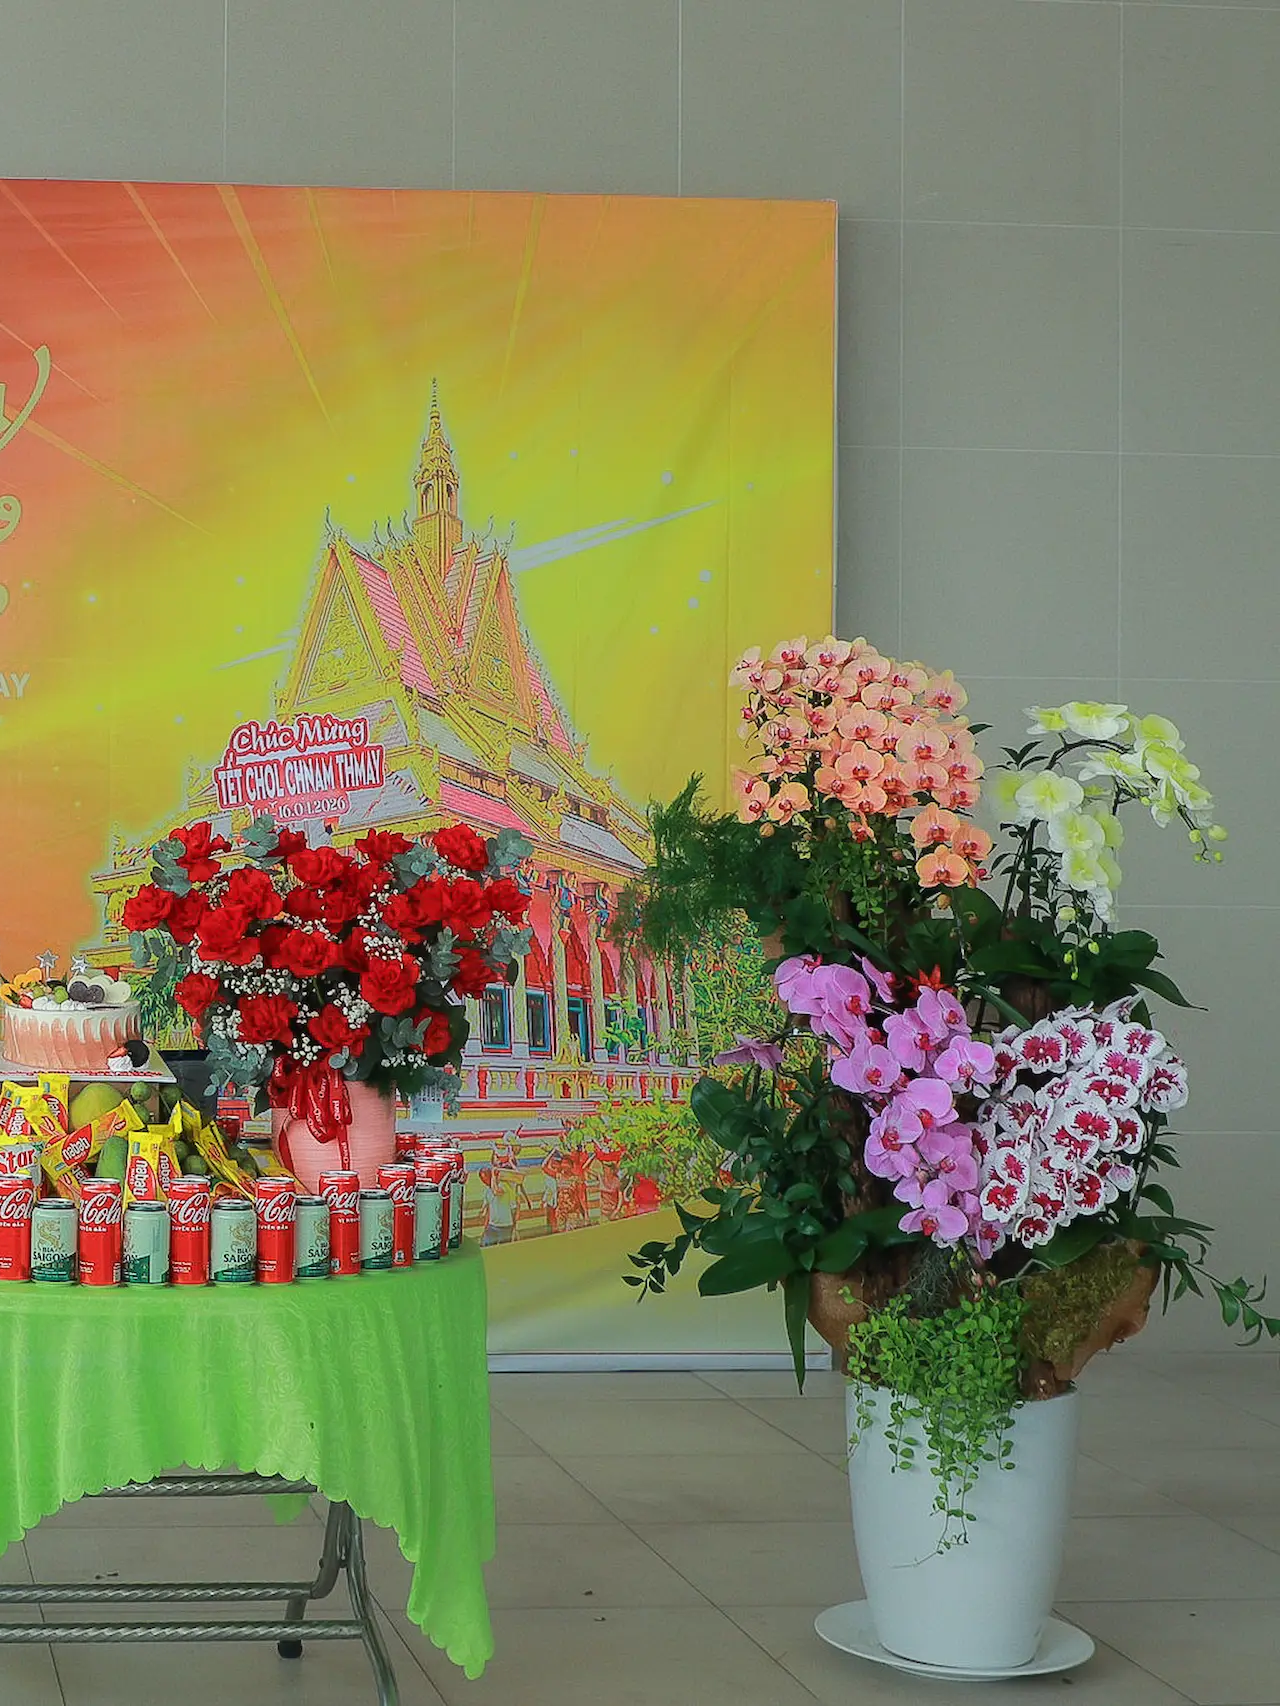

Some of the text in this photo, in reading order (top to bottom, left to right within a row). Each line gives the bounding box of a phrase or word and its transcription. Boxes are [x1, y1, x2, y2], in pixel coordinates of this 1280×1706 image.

[234, 717, 365, 752] Chúc Mừng
[219, 749, 381, 805] TẾT CHOL CHNAM THMAY
[32, 1251, 69, 1262] SAIGON
